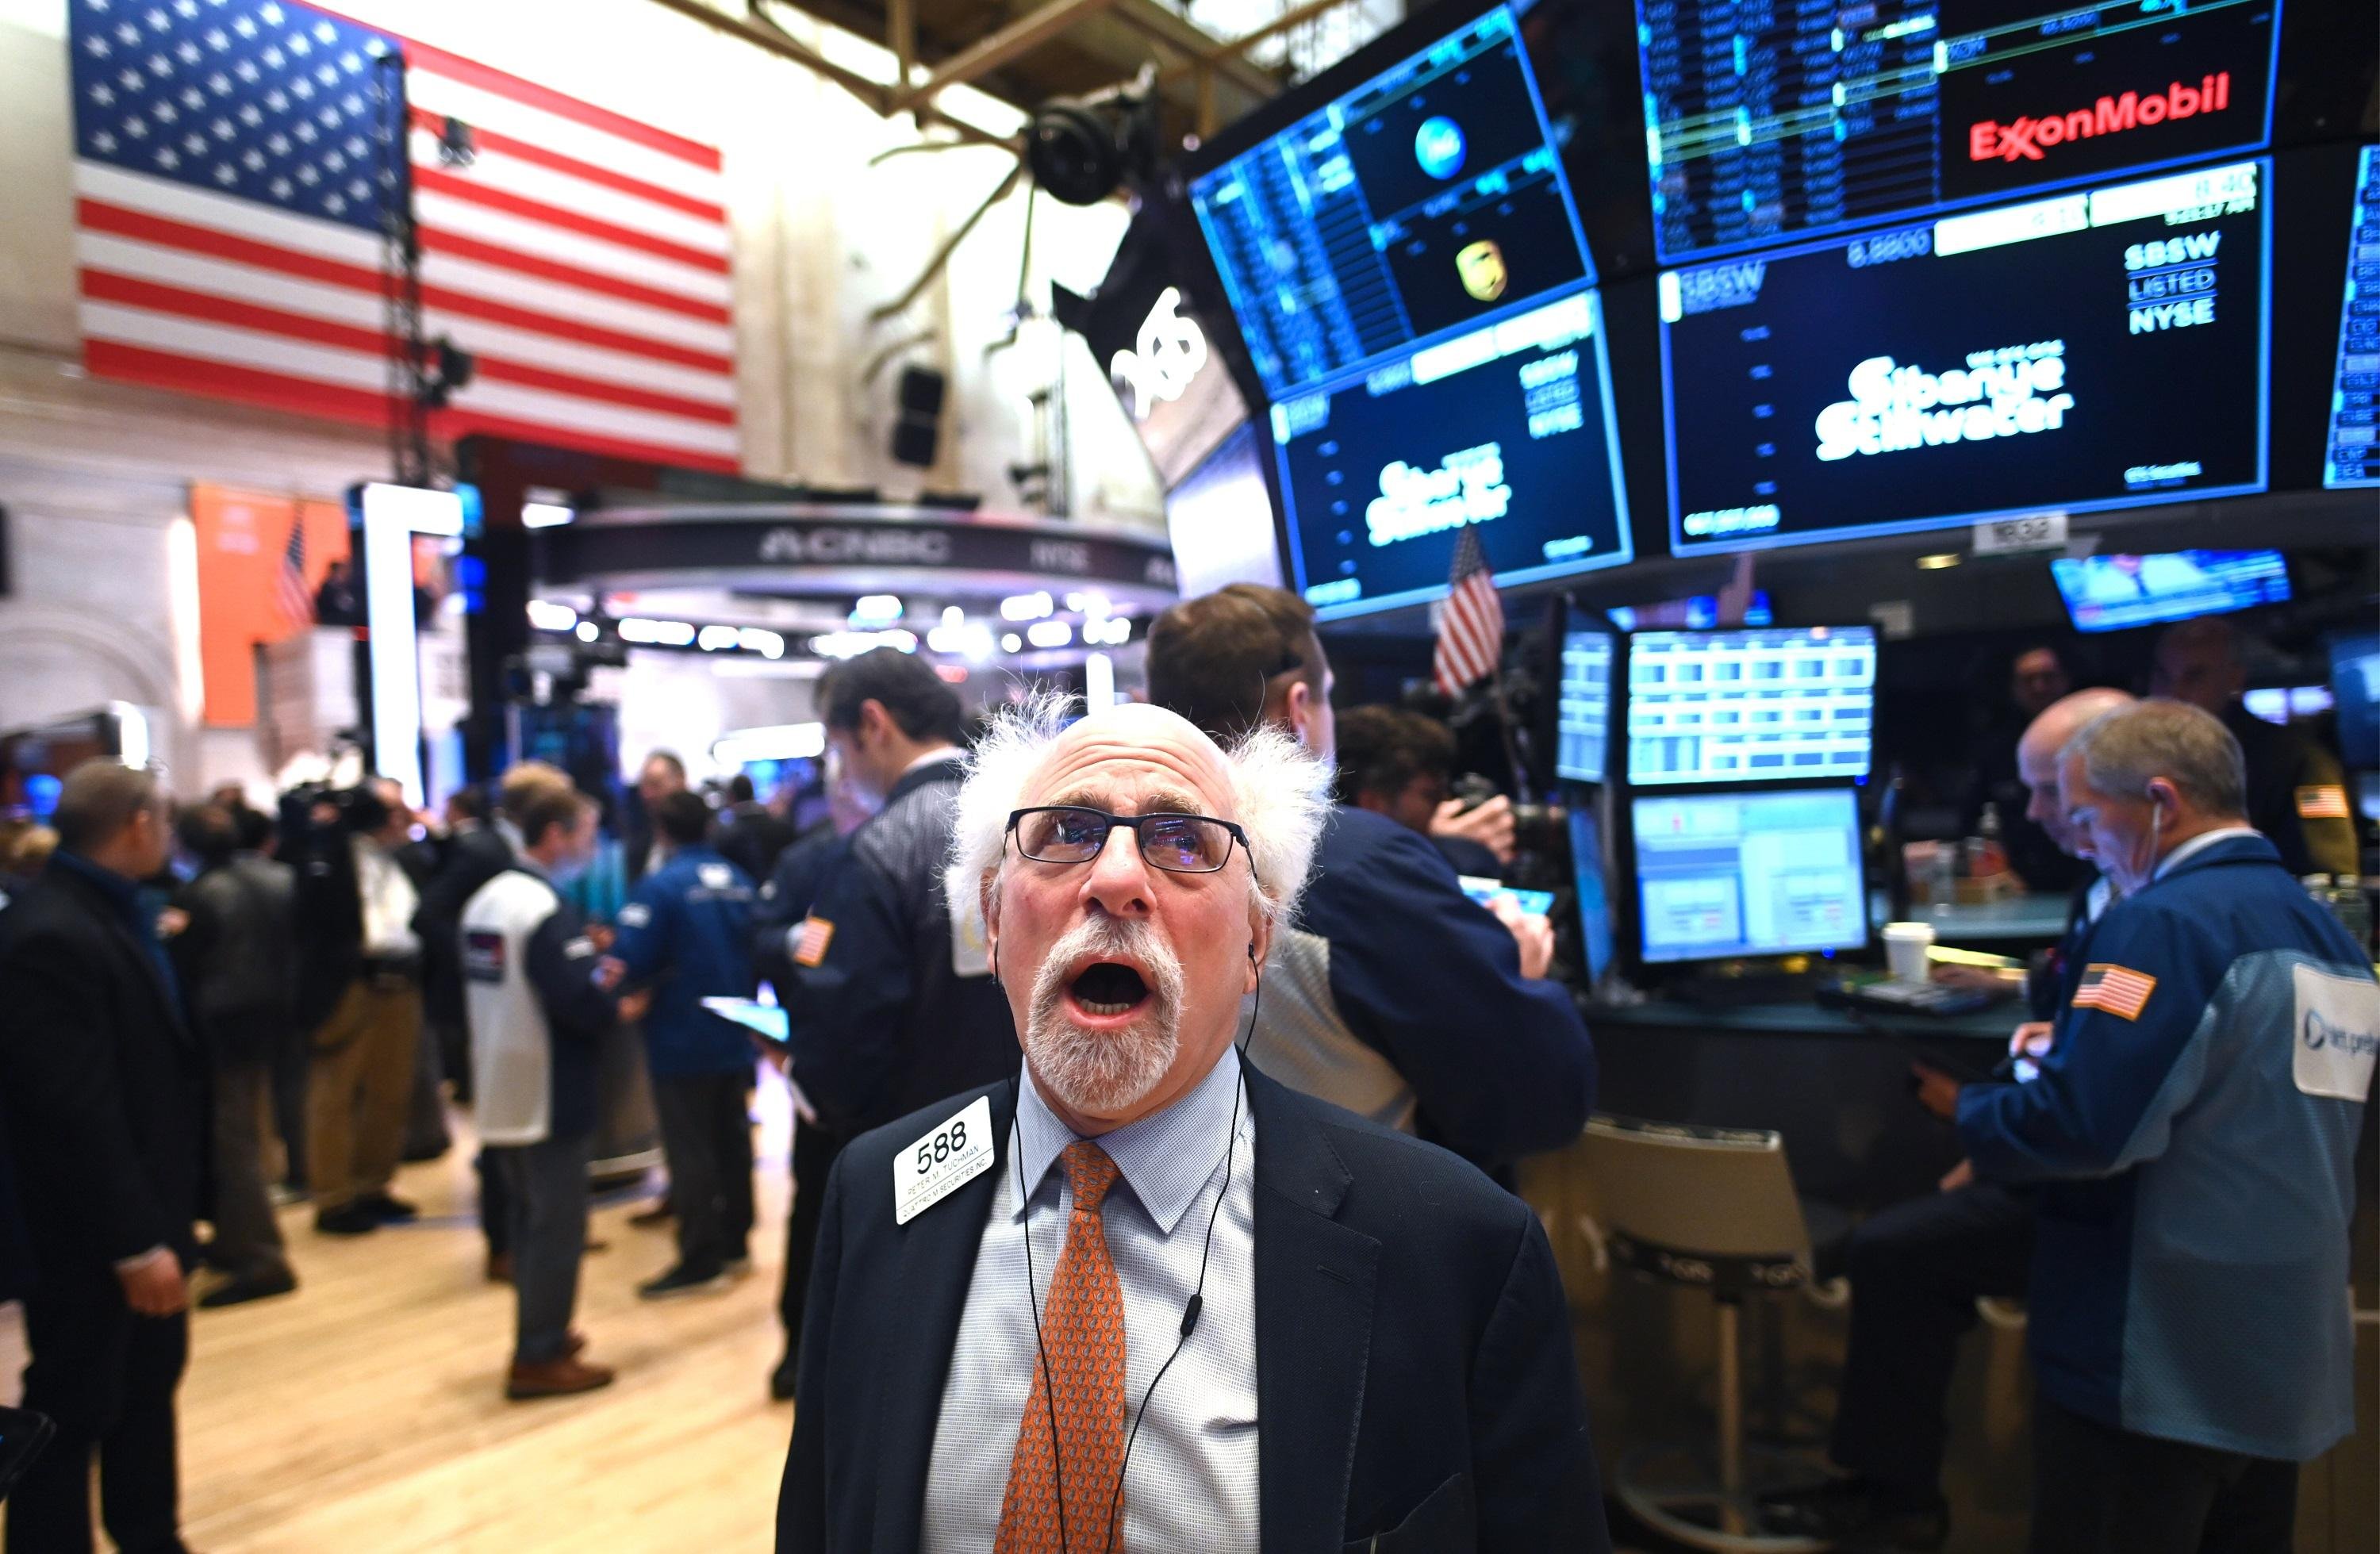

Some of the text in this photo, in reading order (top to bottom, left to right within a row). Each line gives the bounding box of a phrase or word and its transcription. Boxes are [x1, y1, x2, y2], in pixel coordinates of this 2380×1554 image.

[1969, 72, 2228, 161] ExxonMobil
[2125, 230, 2221, 271] SBSW
[2129, 268, 2217, 301] LISTED
[2129, 298, 2217, 335] NYSE
[917, 1121, 966, 1174] 588
[908, 1176, 931, 1195] PETER
[943, 1145, 979, 1173] TUCHMAN
[940, 1165, 974, 1193] SECURITIES
[976, 1158, 988, 1171] INC.
